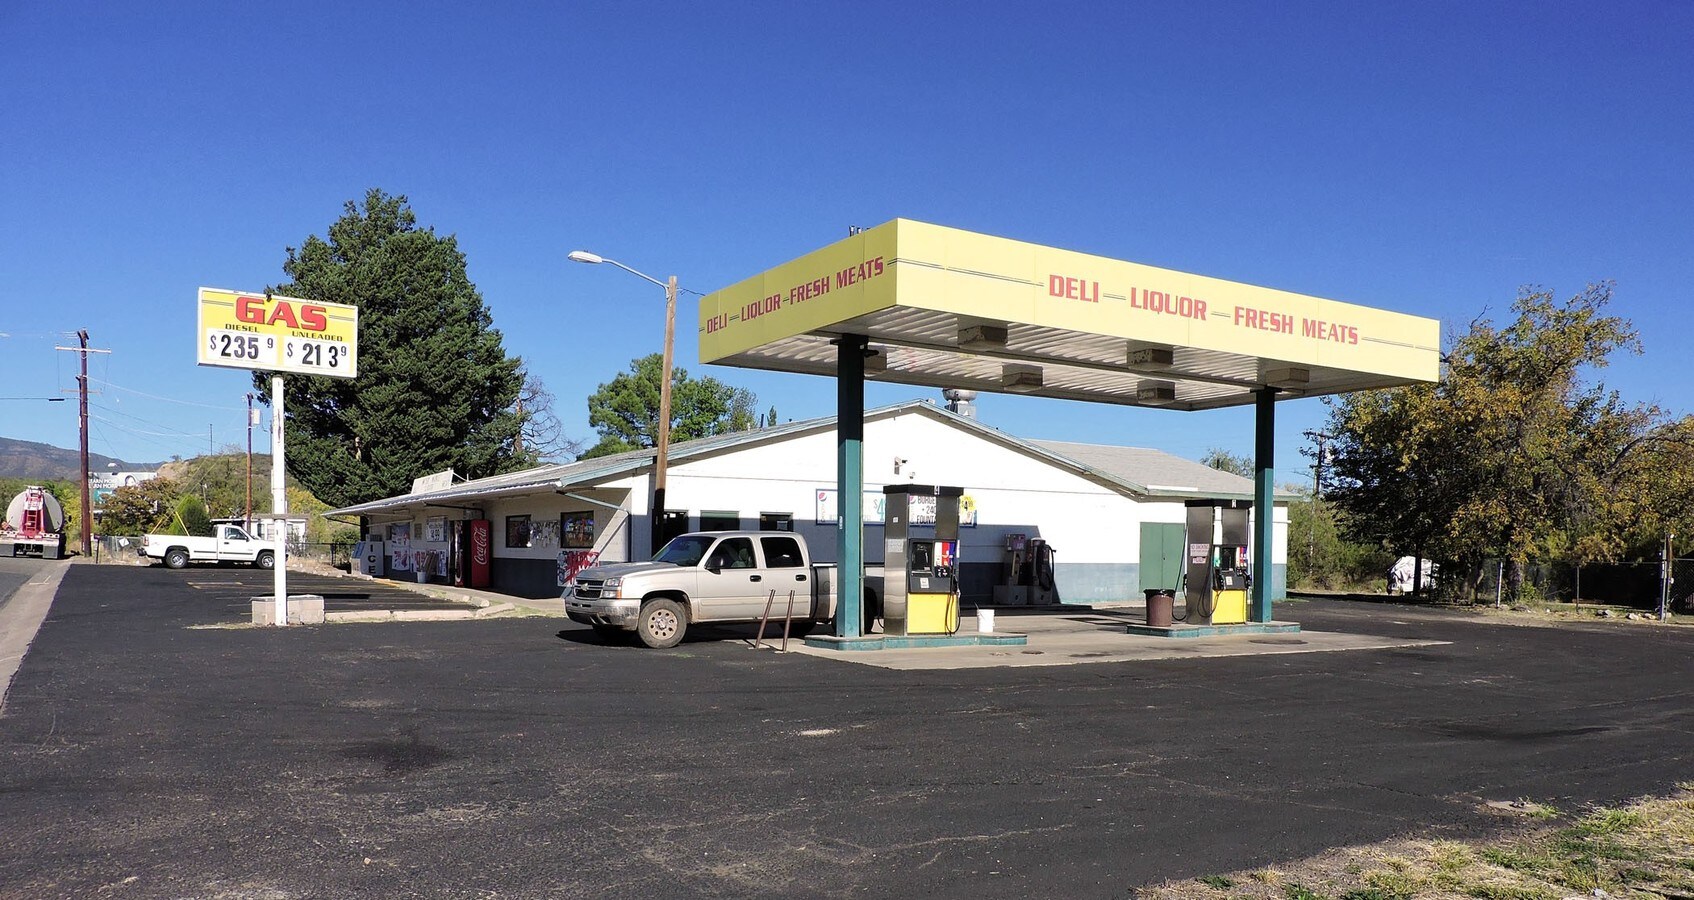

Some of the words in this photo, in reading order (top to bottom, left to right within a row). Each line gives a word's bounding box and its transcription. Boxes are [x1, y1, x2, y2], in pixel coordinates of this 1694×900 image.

[707, 313, 727, 334] DELI
[741, 293, 781, 322] LIQUOR
[790, 276, 830, 305] FRESH
[836, 256, 883, 289] MEATS
[1049, 274, 1099, 303] DELI
[1130, 287, 1207, 321] LIQUOR
[1234, 306, 1293, 335] FRESH
[1302, 318, 1358, 345] MEATS
[225, 323, 260, 333] DIESEL
[235, 296, 327, 332] GAS
[292, 331, 343, 341] UNLEADED
[367, 544, 377, 574] ICE
